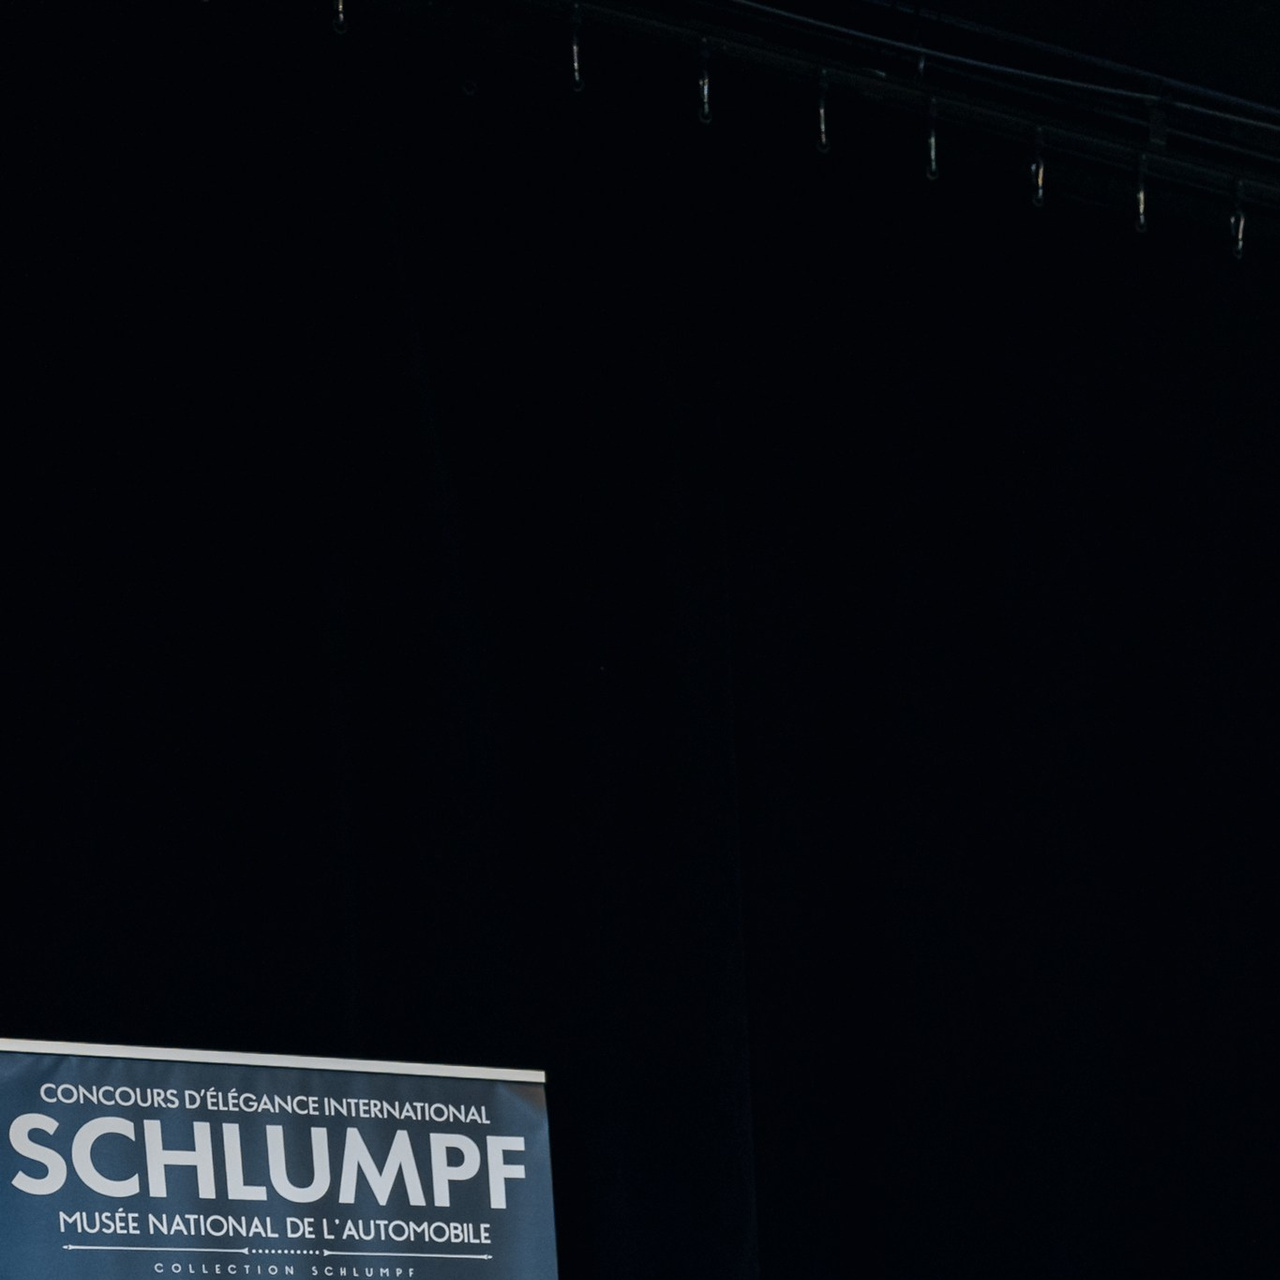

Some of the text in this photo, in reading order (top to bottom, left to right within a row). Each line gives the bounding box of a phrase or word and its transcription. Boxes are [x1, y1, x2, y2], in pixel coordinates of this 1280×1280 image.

[40, 1083, 180, 1109] CONCOURS
[324, 1097, 491, 1124] INTERNATIONAL
[8, 1112, 526, 1210] SCHLUMPF
[59, 1207, 141, 1235] MUSÉE
[148, 1213, 280, 1239] NATIONAL
[286, 1217, 316, 1240] DE
[154, 1262, 416, 1278] COLLECTION SCHLUMPF
